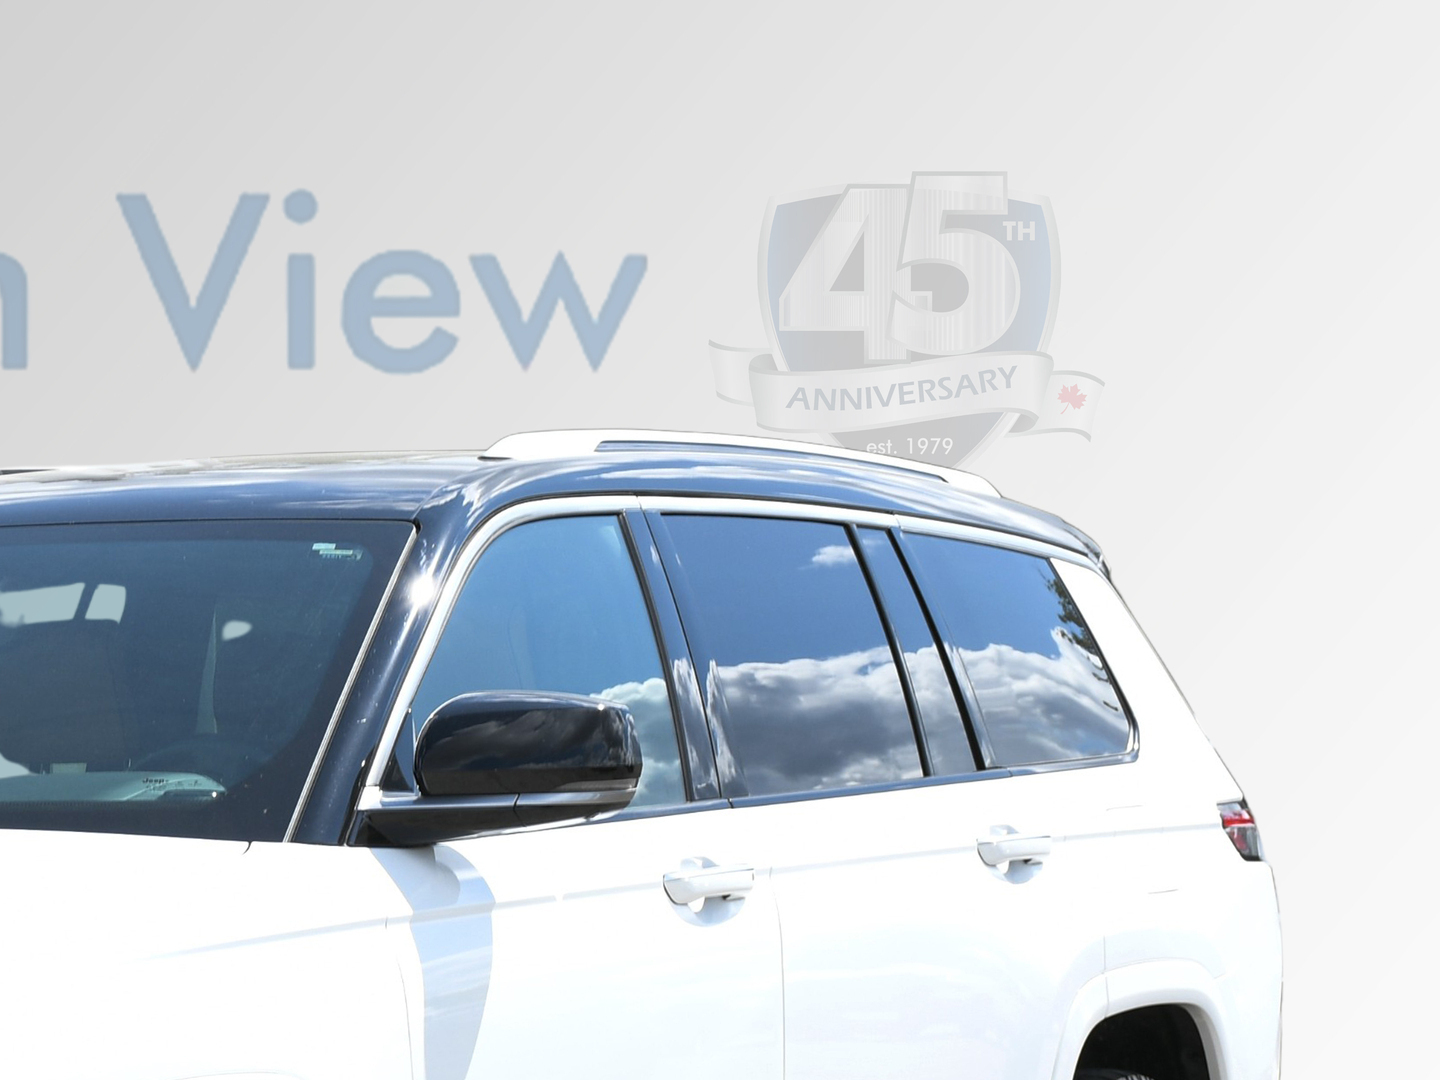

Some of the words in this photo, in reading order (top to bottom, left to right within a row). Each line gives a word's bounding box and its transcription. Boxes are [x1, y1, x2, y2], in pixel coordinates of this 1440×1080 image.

[1002, 221, 1036, 241] TH
[116, 189, 648, 375] View
[778, 170, 1021, 364] 45
[785, 365, 1018, 412] ANNIVERSARY
[906, 437, 954, 455] 1979
